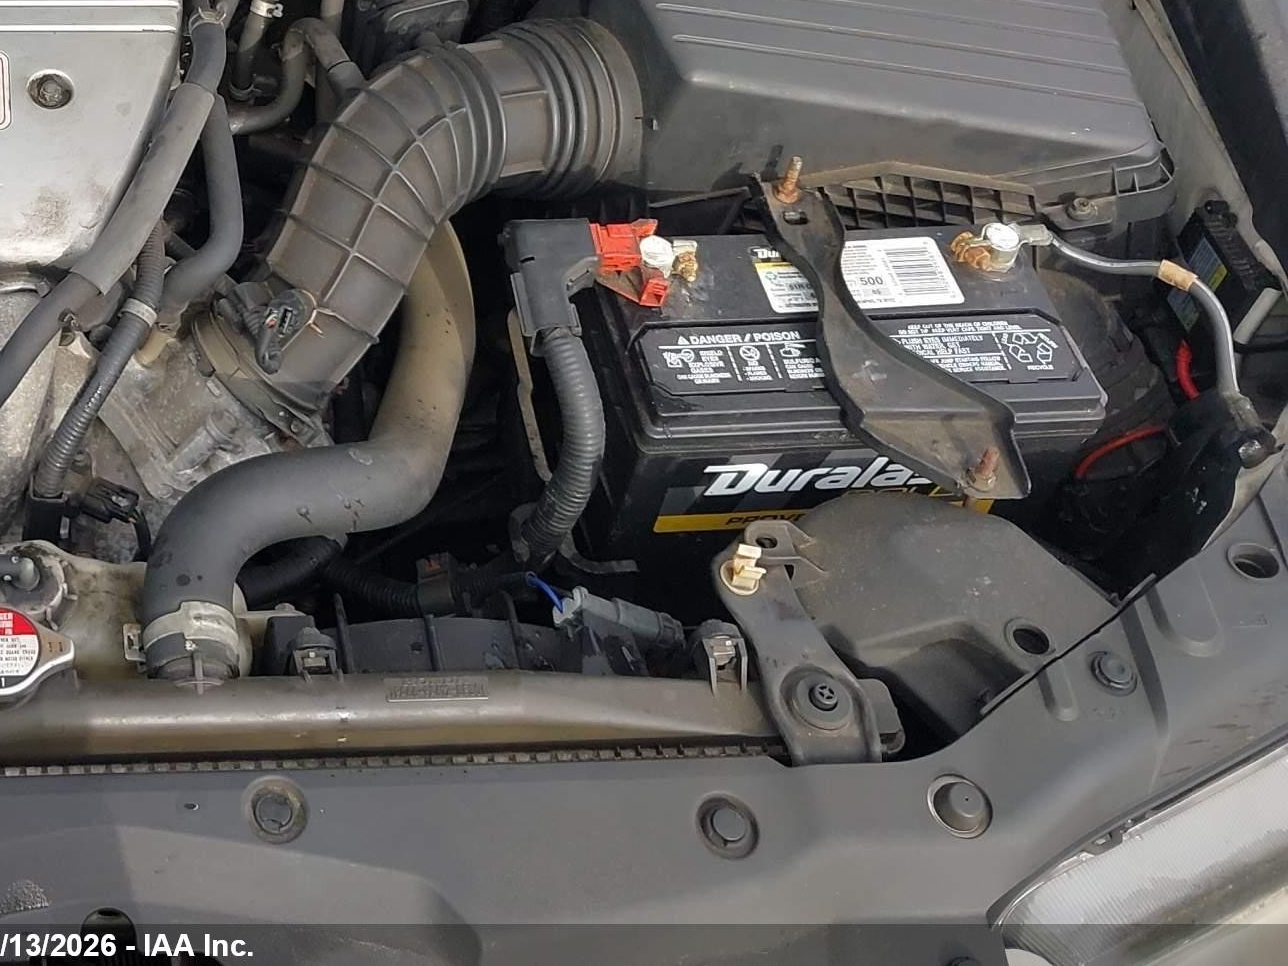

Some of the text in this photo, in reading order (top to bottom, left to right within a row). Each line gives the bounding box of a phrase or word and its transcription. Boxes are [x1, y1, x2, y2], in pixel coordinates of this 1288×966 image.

[859, 276, 883, 286] 500
[689, 333, 743, 345] DANGER
[754, 330, 800, 342] POISON
[923, 336, 941, 344] EYES
